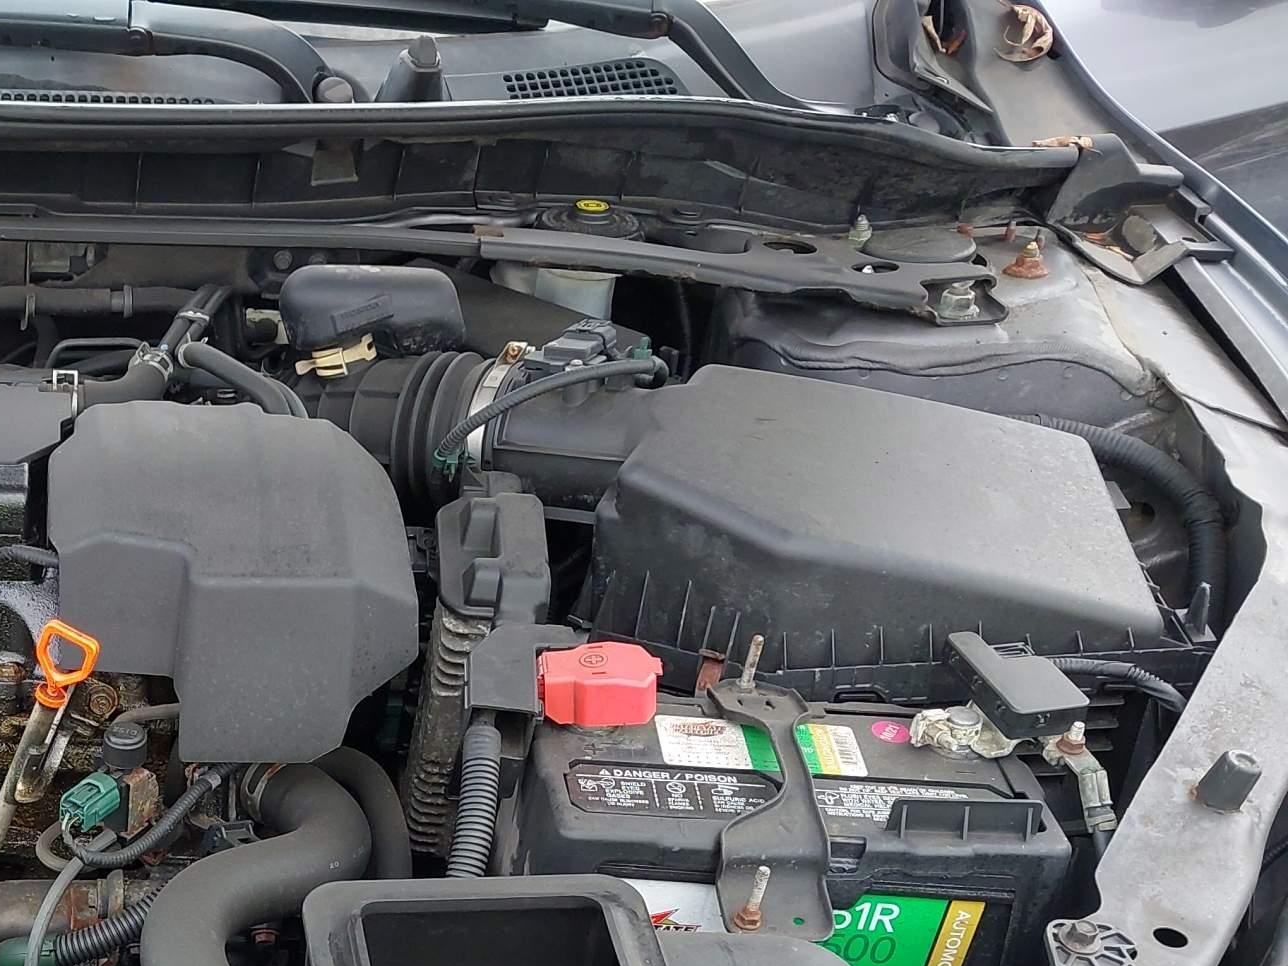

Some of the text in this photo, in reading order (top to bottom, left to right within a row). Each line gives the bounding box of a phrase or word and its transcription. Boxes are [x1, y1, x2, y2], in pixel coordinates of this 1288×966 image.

[613, 768, 738, 784] DANGER / POISON
